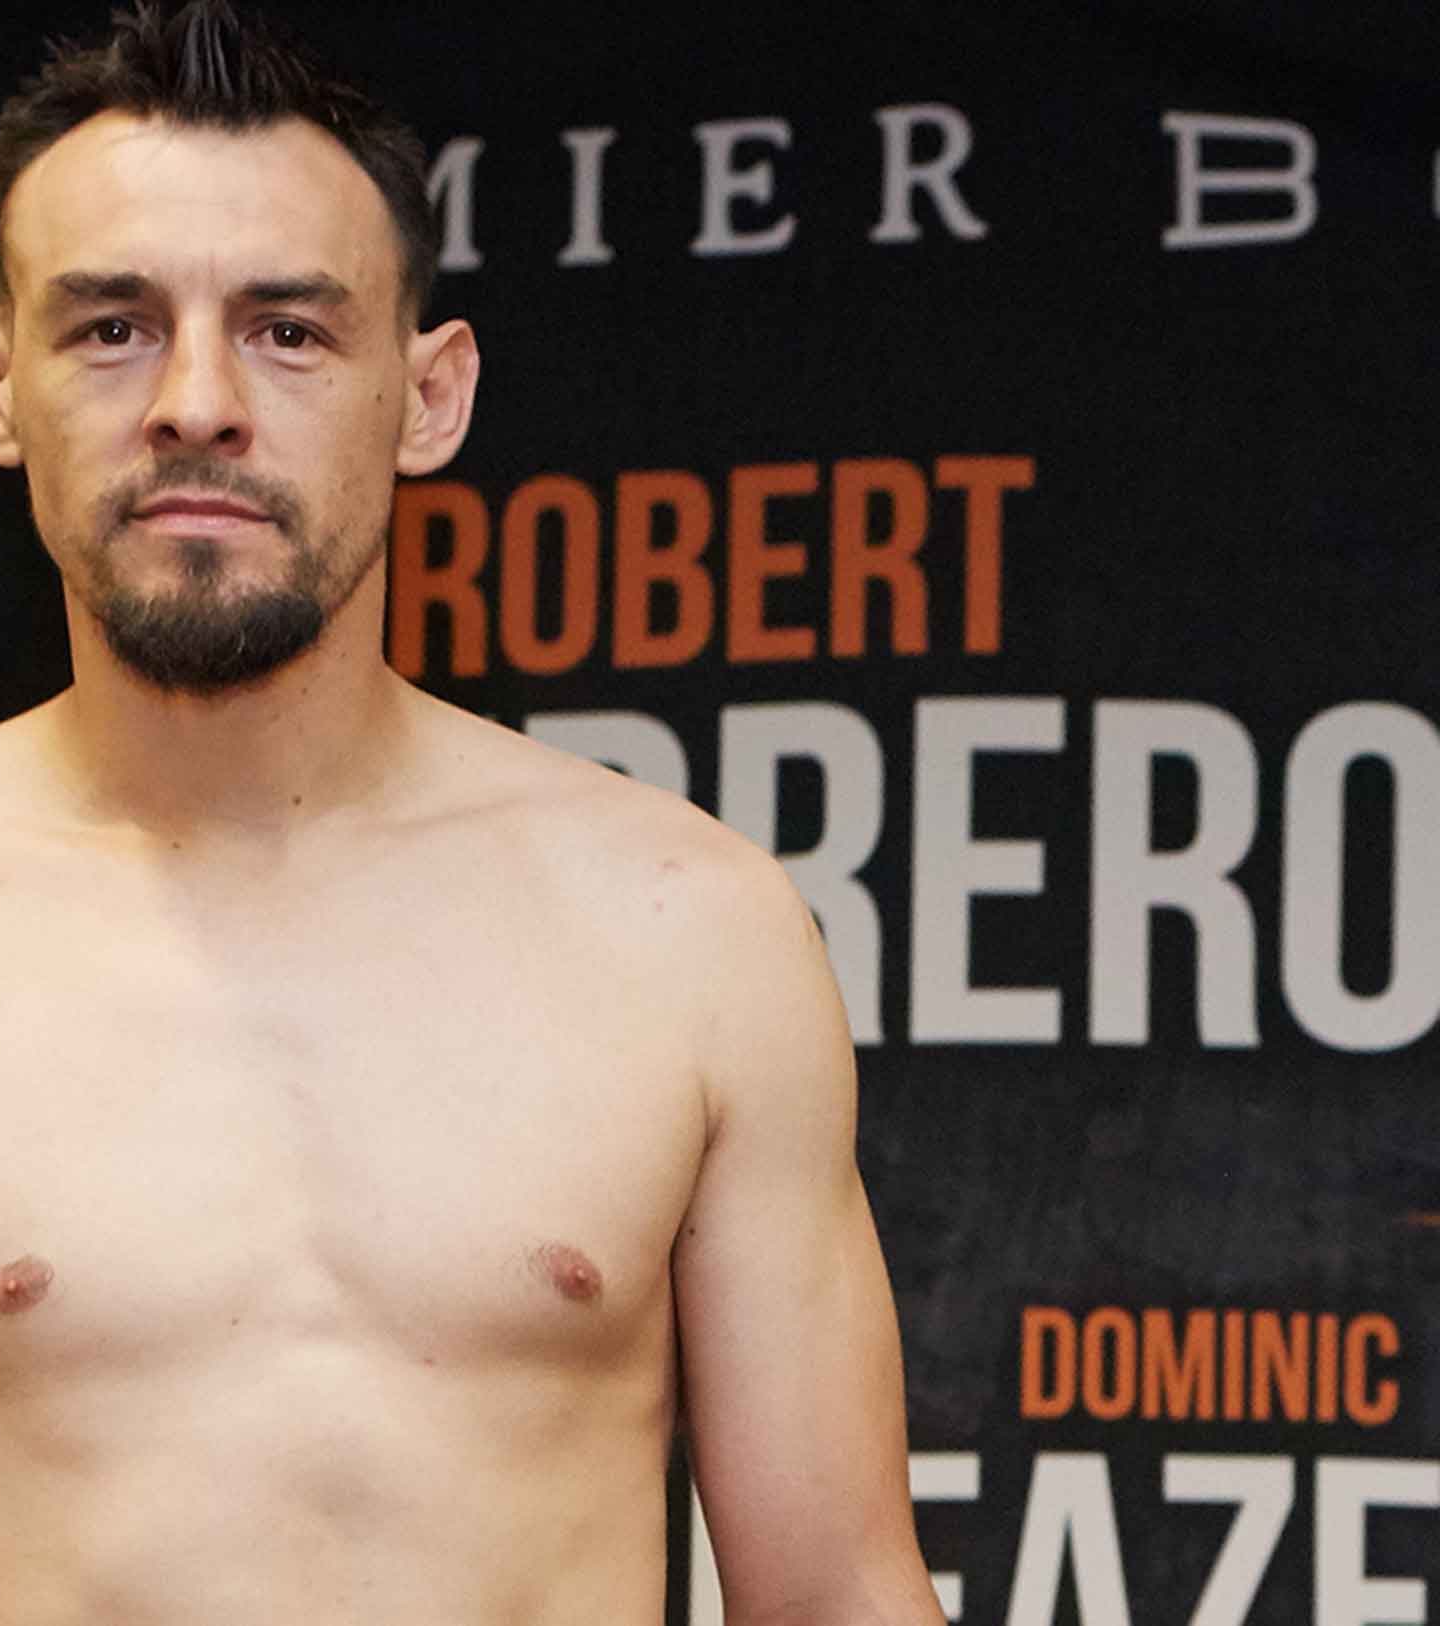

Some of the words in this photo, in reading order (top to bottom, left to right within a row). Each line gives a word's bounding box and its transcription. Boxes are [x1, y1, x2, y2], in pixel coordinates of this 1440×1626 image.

[1161, 110, 1440, 250] B
[389, 456, 1036, 679] ROBERT
[484, 697, 1440, 1054] RERO
[1020, 1306, 1401, 1427] DOMINIC
